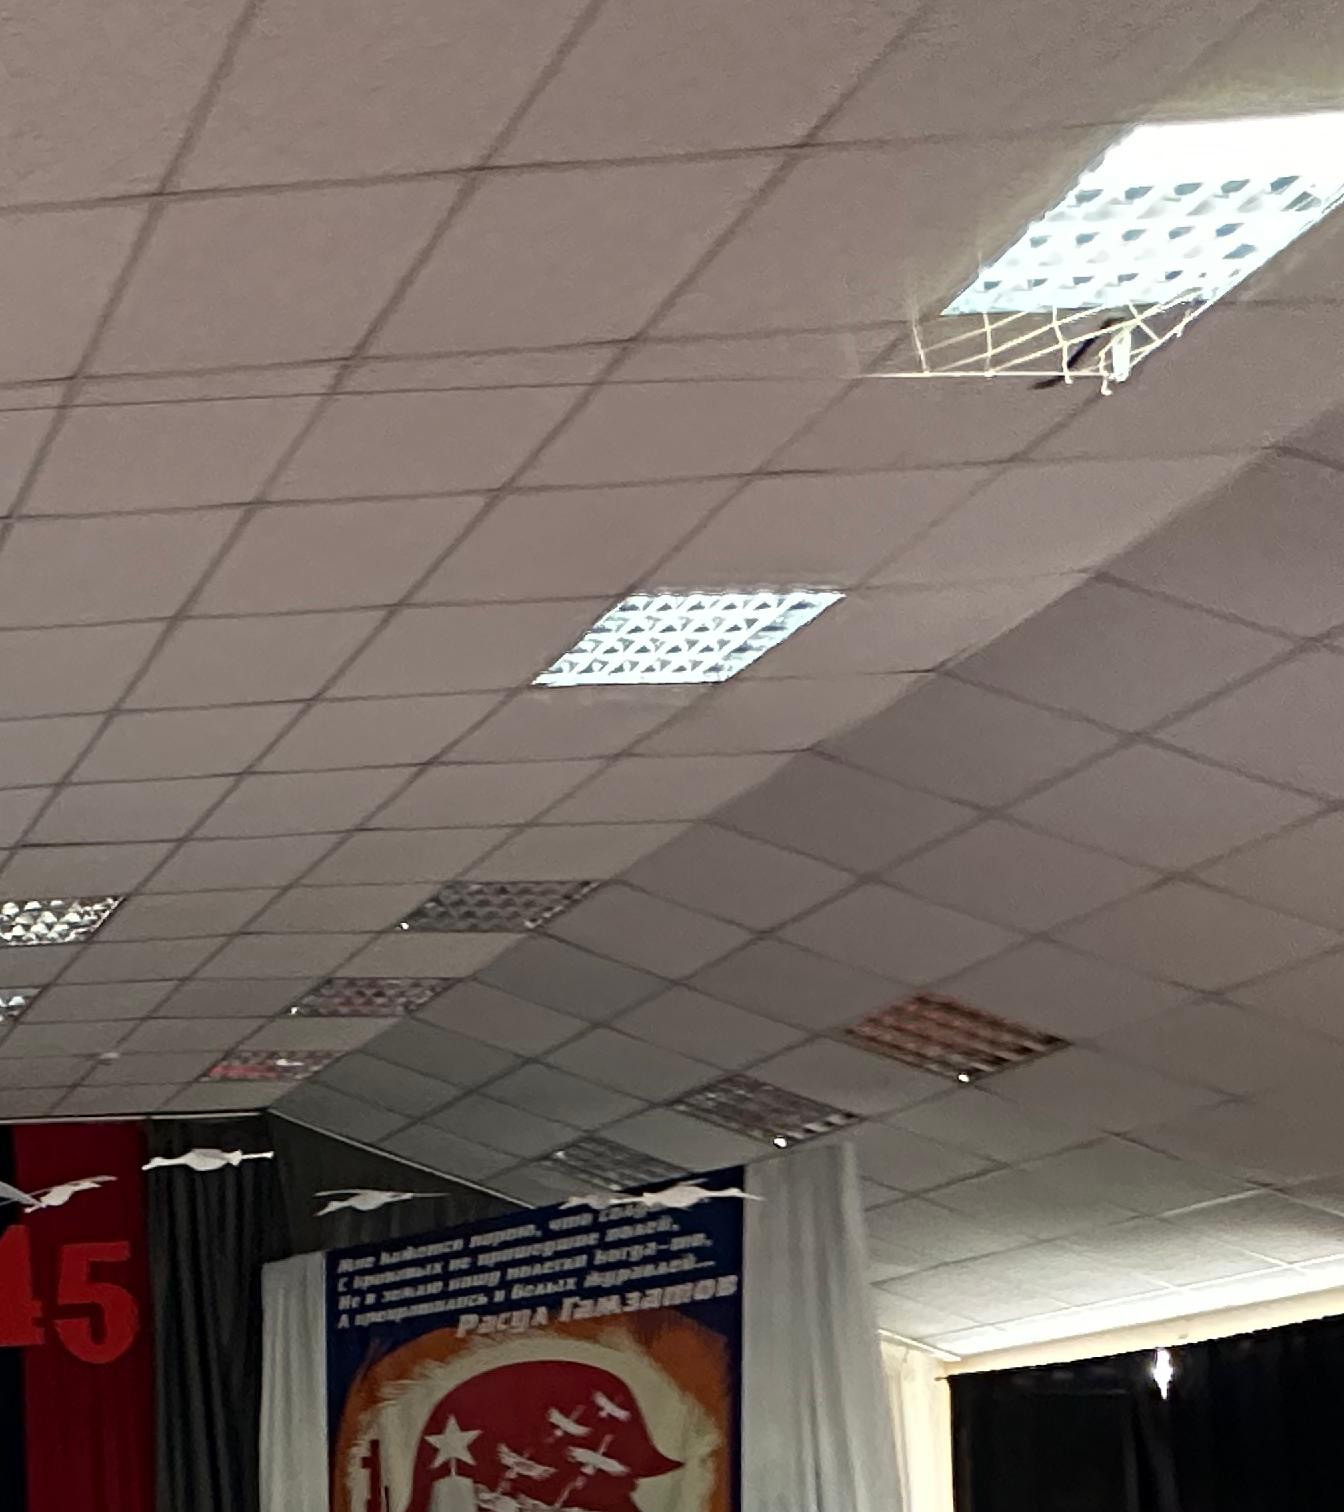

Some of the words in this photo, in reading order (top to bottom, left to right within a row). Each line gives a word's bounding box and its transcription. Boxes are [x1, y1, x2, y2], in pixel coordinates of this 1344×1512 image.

[337, 1276, 348, 1292] С
[448, 1257, 473, 1272] не
[337, 1313, 350, 1329] А
[456, 1306, 549, 1338] Расул
[559, 1275, 739, 1322] Гамзатов
